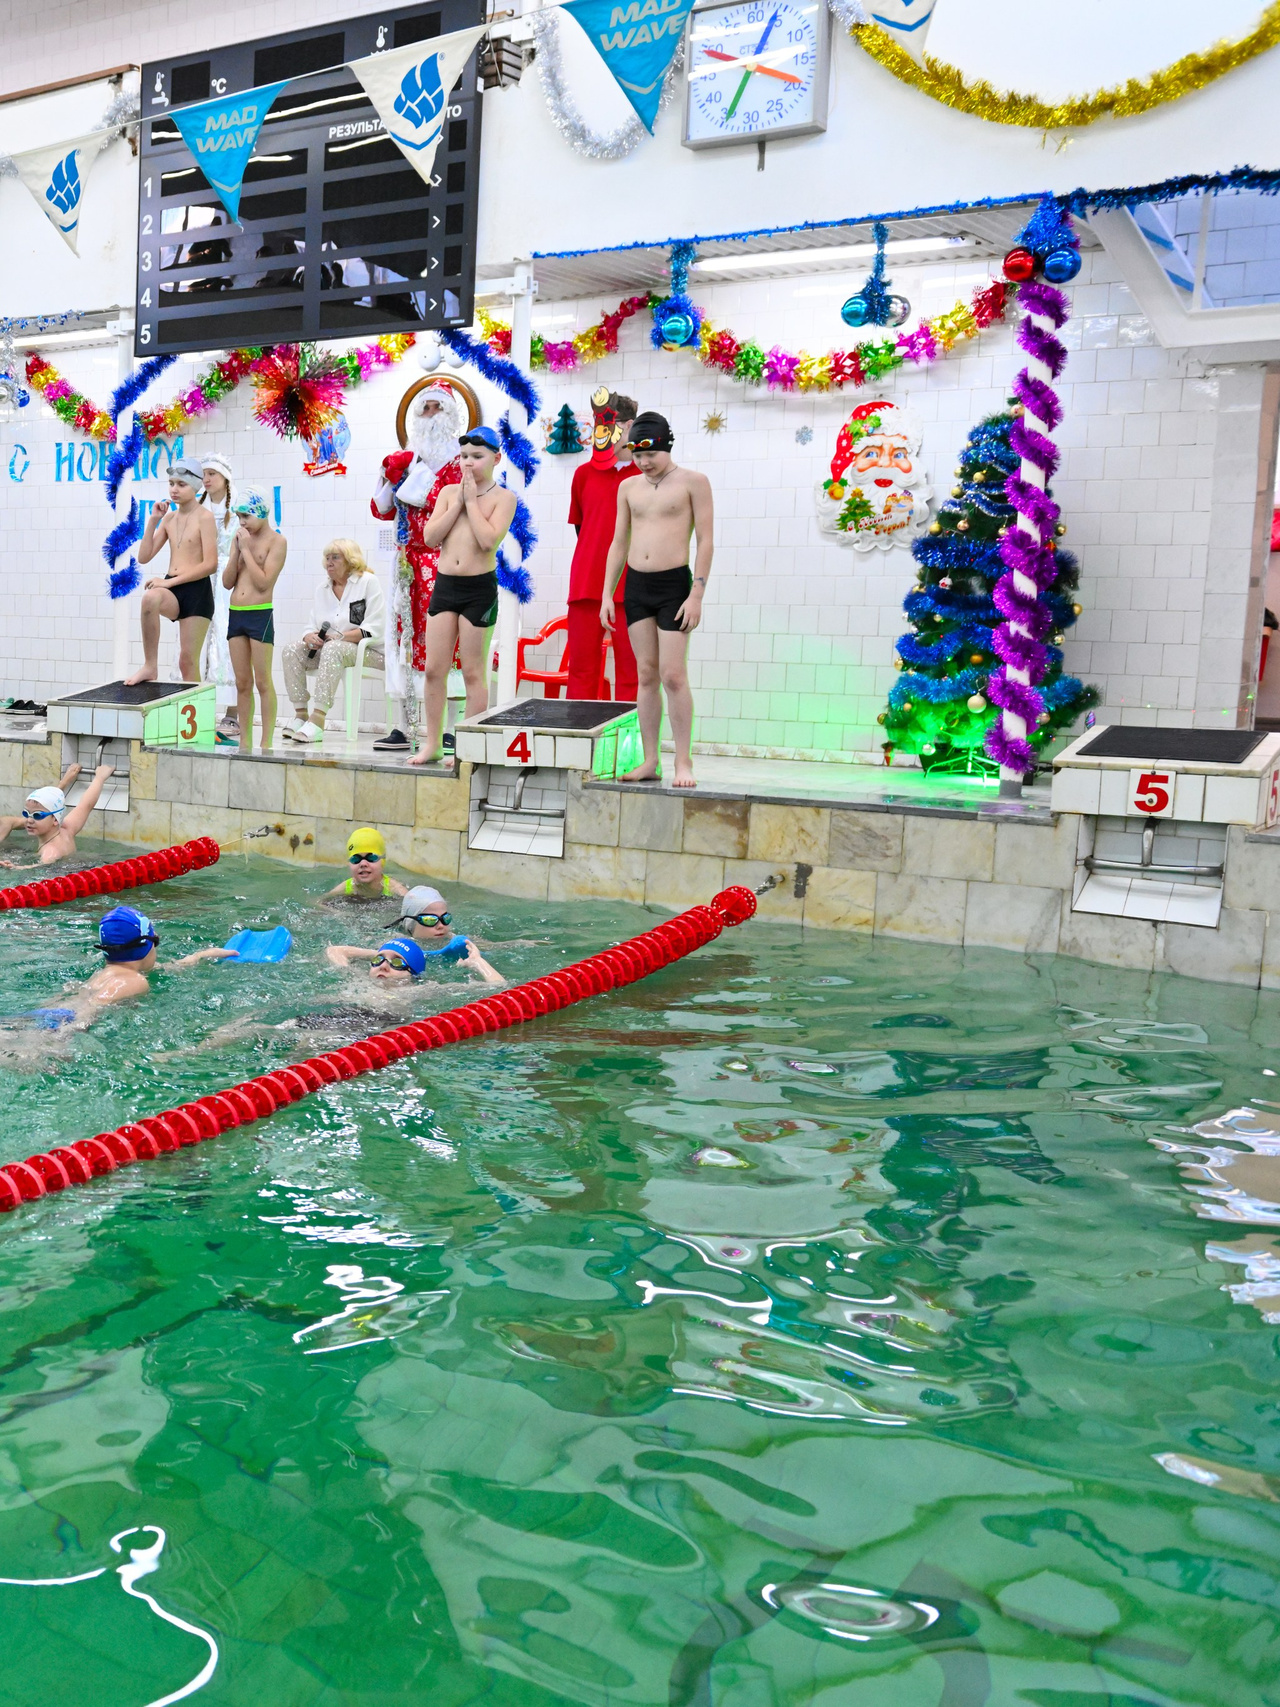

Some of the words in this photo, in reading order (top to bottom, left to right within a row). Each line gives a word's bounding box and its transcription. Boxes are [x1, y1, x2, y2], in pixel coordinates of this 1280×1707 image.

[610, 0, 682, 28] MAD
[747, 9, 765, 24] 60
[774, 15, 783, 28] 5
[600, 10, 687, 51] WAVE
[787, 29, 803, 43] 10
[793, 52, 809, 66] 15
[705, 91, 722, 104] 40
[766, 98, 784, 112] 25
[204, 105, 258, 133] MAD
[743, 111, 760, 125] 30
[329, 119, 388, 139] РЕЗУЛЬТА
[144, 177, 153, 198] 1
[142, 214, 153, 235] 2
[141, 251, 152, 272] 3
[140, 287, 152, 308] 4
[140, 323, 151, 345] 5
[9, 444, 30, 482] С
[180, 704, 198, 740] 3
[506, 731, 531, 764] 4
[1133, 773, 1170, 813] 5
[1269, 769, 1280, 821] 5
